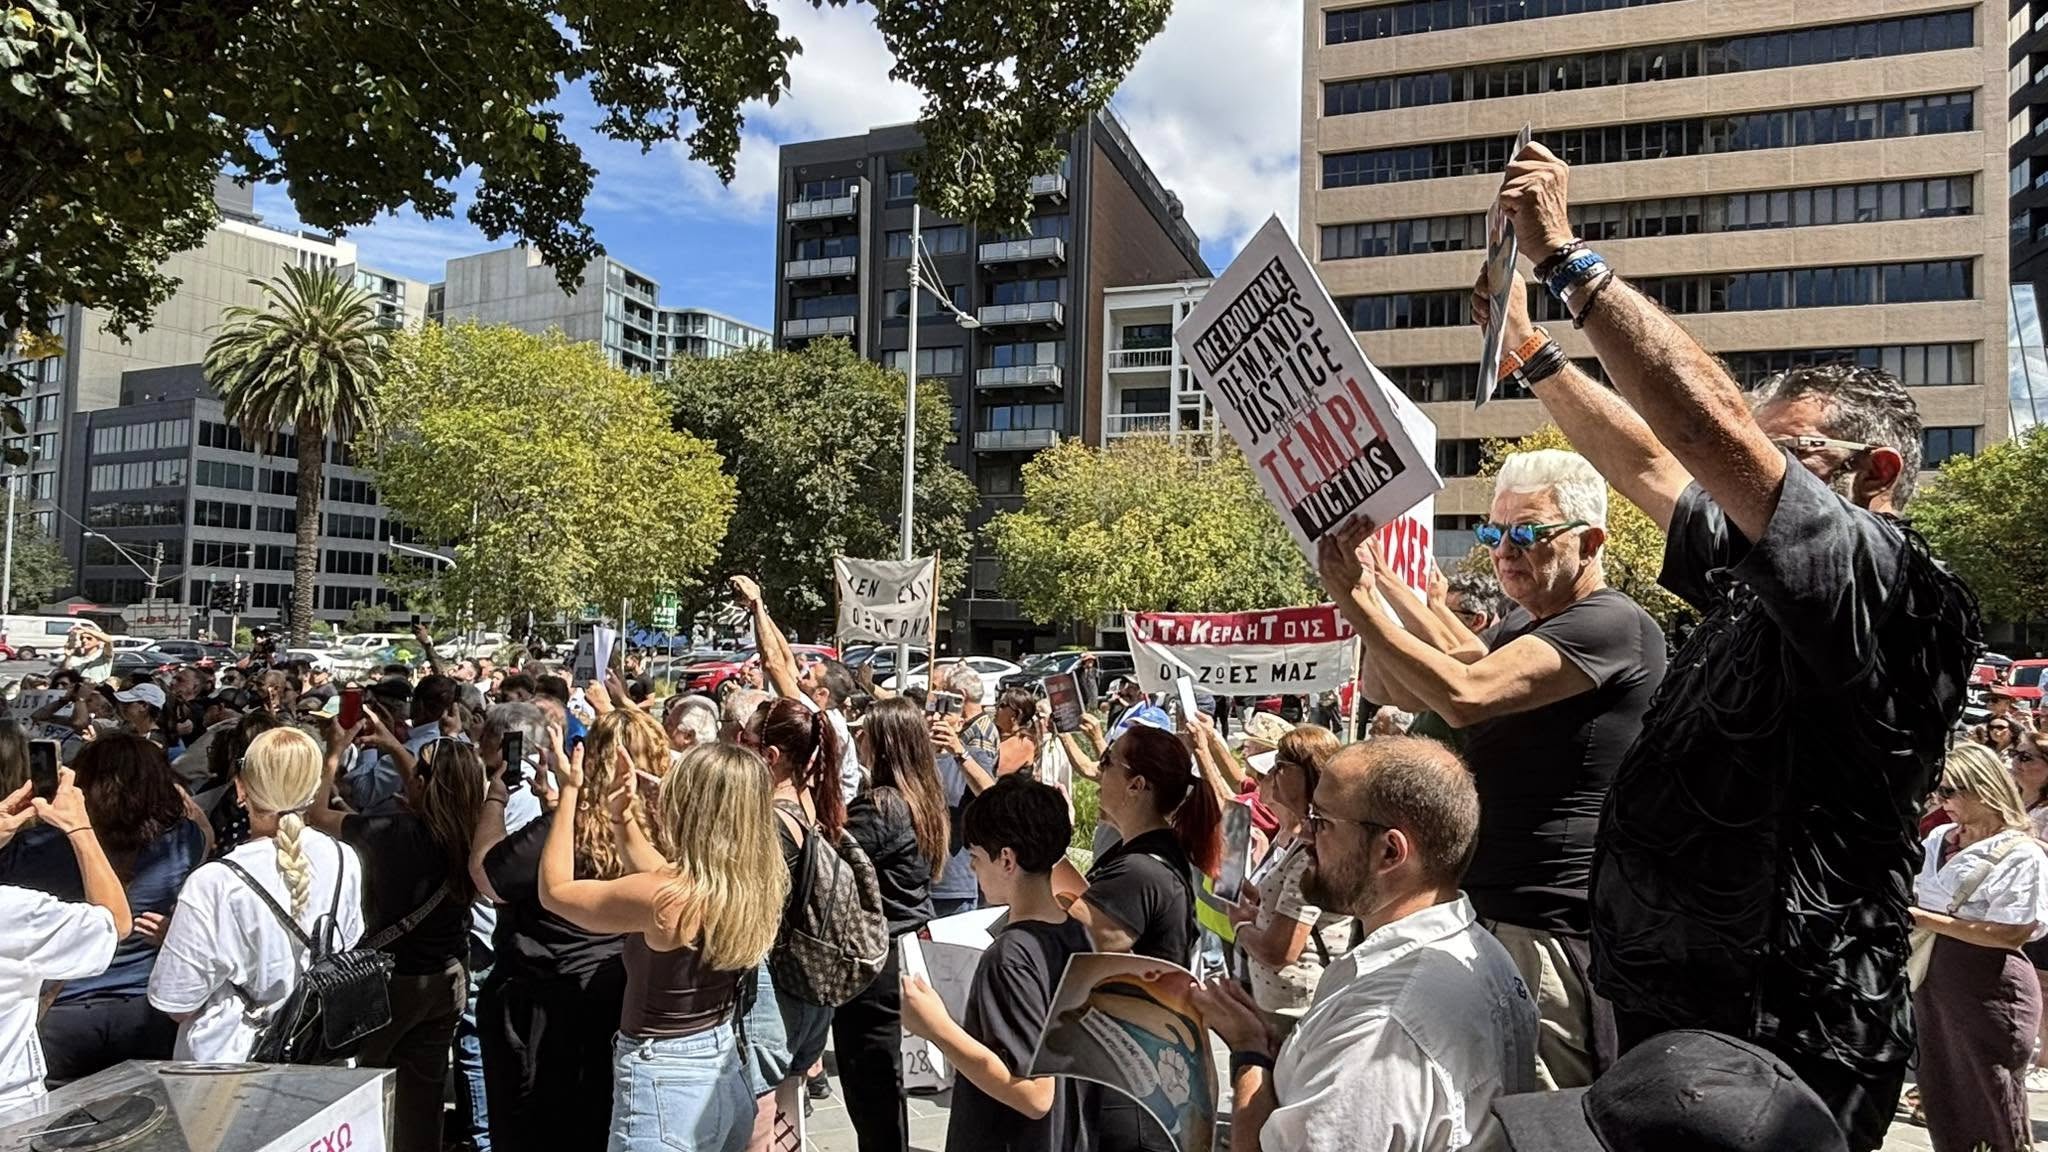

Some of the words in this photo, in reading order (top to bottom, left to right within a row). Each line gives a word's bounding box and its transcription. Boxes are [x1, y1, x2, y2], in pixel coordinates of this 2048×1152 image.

[1198, 259, 1291, 368] MELBOURNE
[1218, 288, 1314, 407] DEMANDS
[1236, 327, 1342, 444] JUSTICE
[1259, 378, 1389, 514] TEMPI
[1301, 446, 1393, 529] VICTIMS
[1271, 661, 1318, 682] ΜΑΣ
